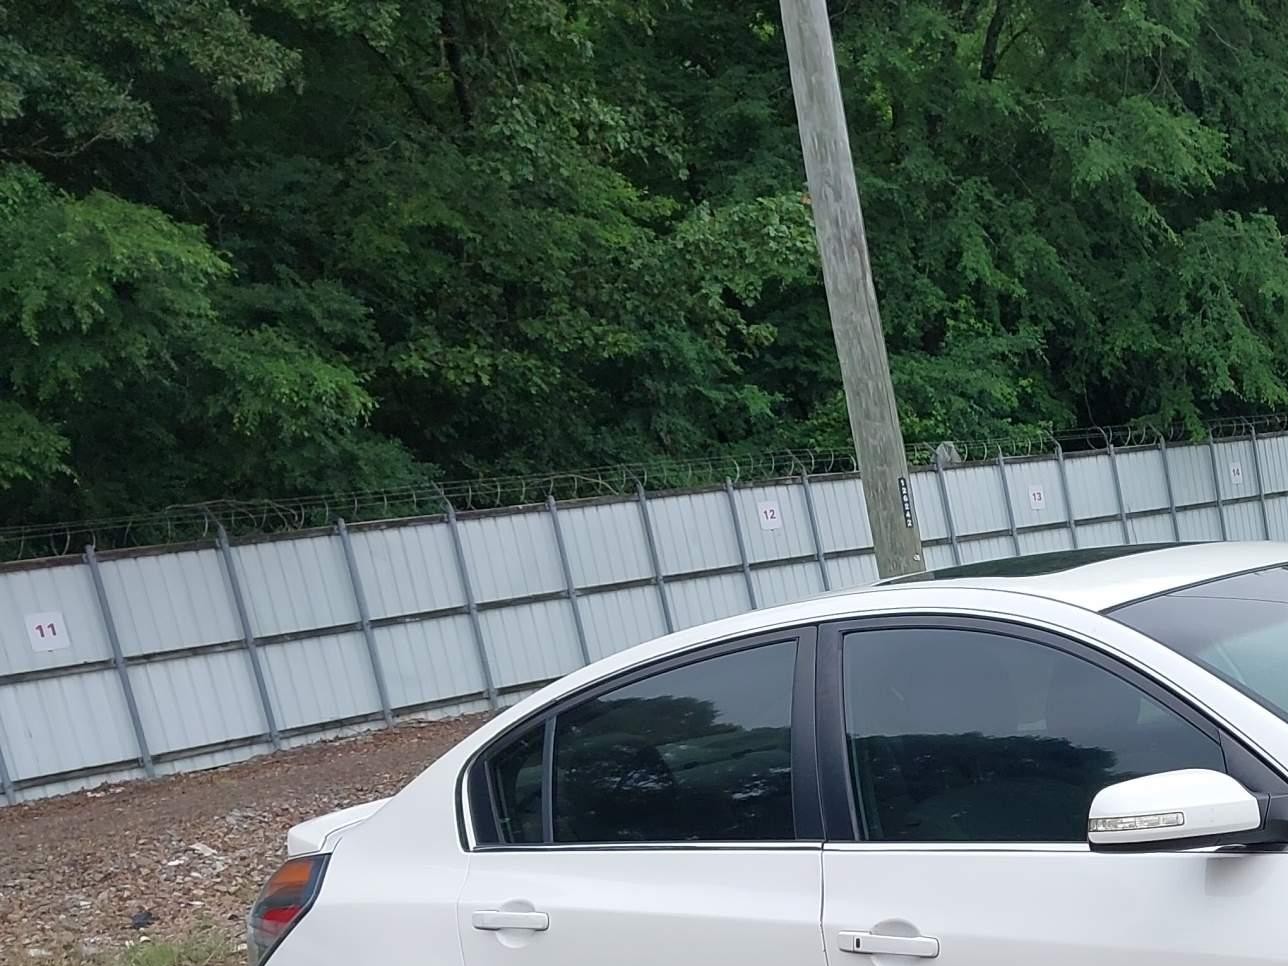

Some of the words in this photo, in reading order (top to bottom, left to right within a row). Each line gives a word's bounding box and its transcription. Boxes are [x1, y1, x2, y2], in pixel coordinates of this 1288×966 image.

[1232, 467, 1241, 477] 14
[1032, 491, 1042, 502] 13
[763, 508, 777, 521] 12
[35, 622, 58, 638] 11
